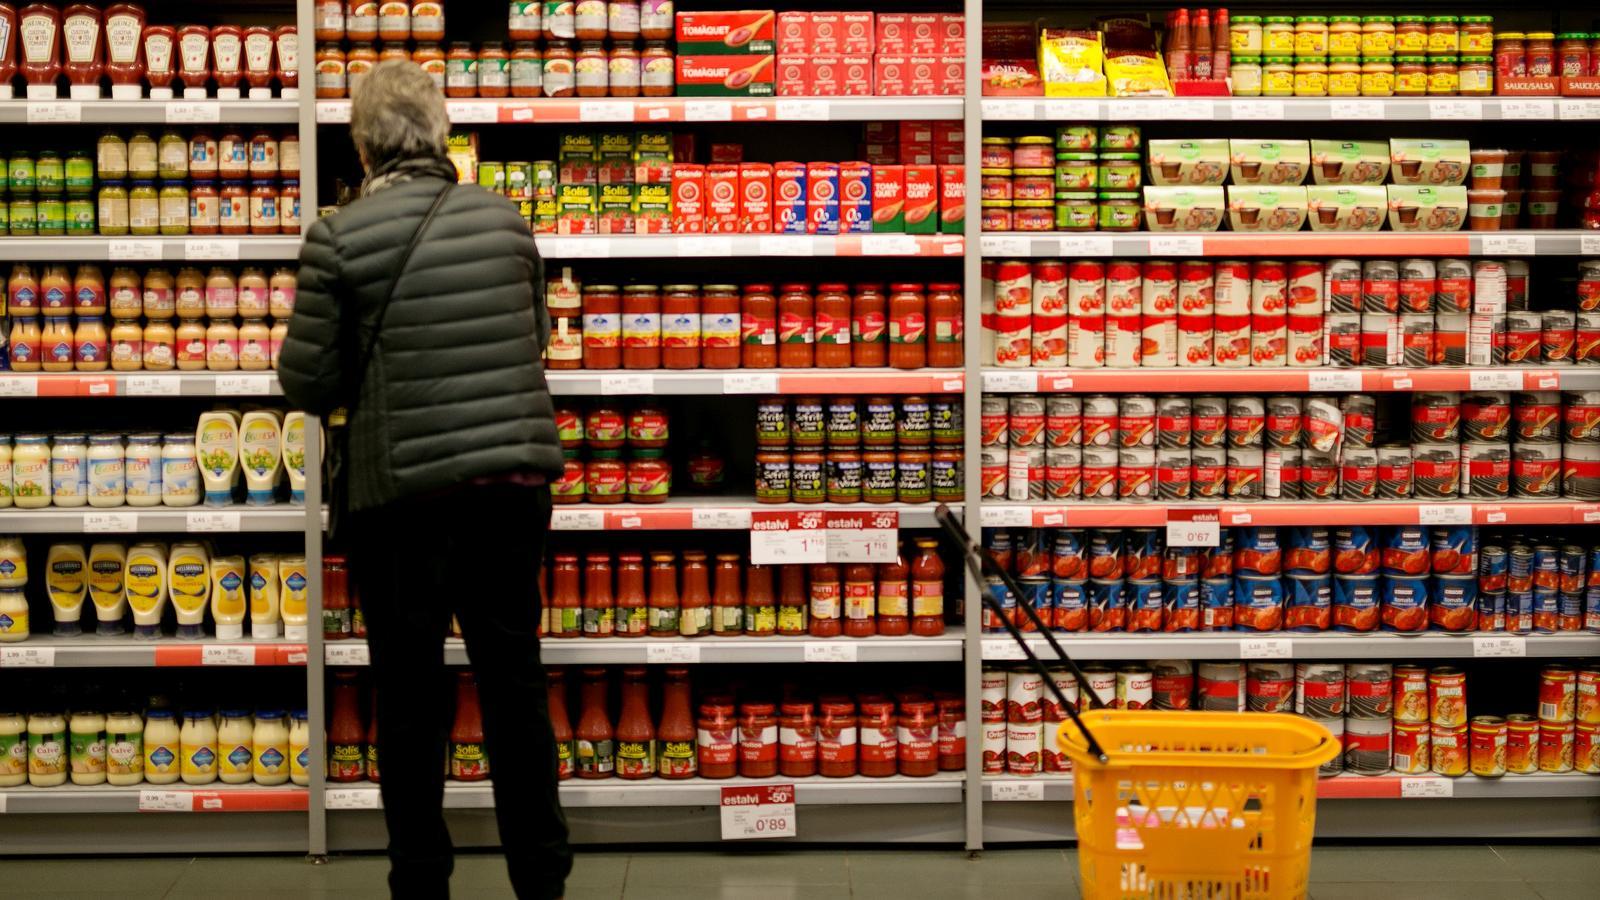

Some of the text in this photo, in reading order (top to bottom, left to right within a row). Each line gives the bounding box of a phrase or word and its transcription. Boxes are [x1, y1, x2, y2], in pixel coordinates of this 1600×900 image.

[1504, 82, 1554, 90] SAUCE/SALSA
[1192, 513, 1218, 522] estalvi
[754, 520, 789, 530] estalvi
[827, 520, 862, 529] estalvi
[1187, 532, 1210, 542] 0'67
[724, 794, 759, 805] estalvi
[756, 818, 786, 831] 0'89
